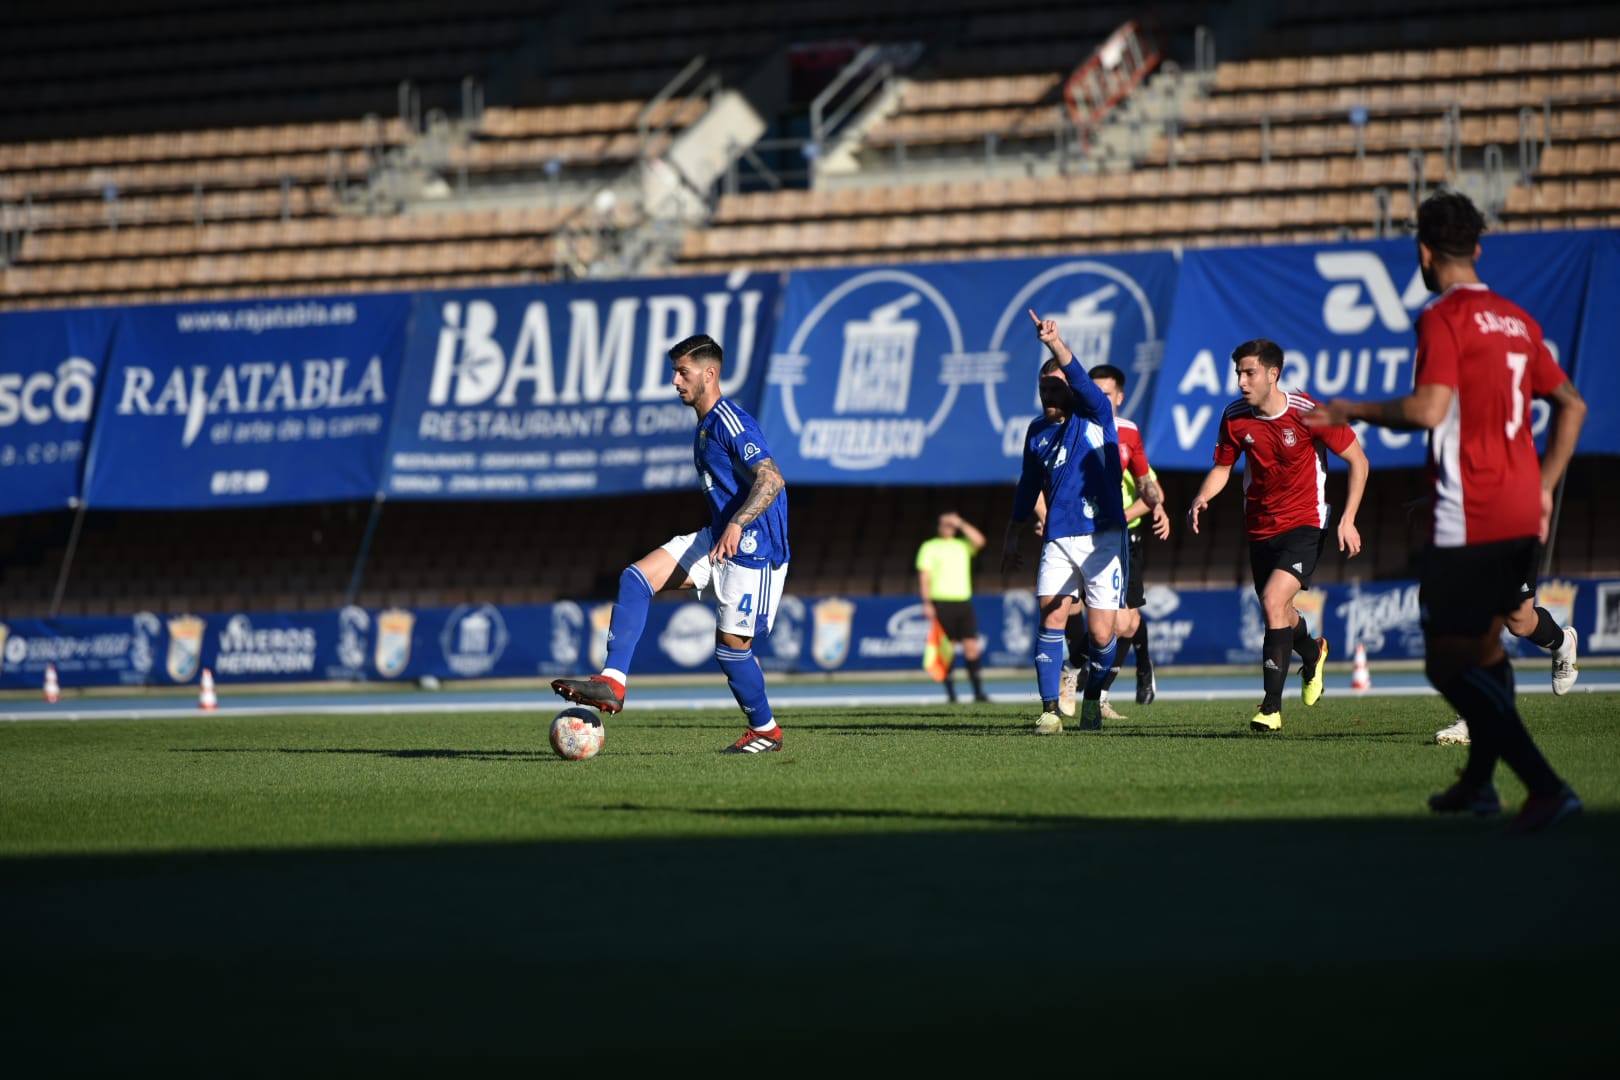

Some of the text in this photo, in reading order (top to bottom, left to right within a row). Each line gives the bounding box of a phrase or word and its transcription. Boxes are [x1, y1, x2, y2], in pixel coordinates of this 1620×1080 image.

[177, 302, 357, 334] www.rajatabla.es
[117, 355, 386, 447] RAJATABLA
[233, 418, 274, 442] arte
[278, 415, 303, 439] de
[329, 413, 382, 437] carne
[419, 408, 610, 441] RESTAURANT
[610, 406, 632, 436] &
[1112, 567, 1120, 590] 6
[738, 593, 753, 617] 4
